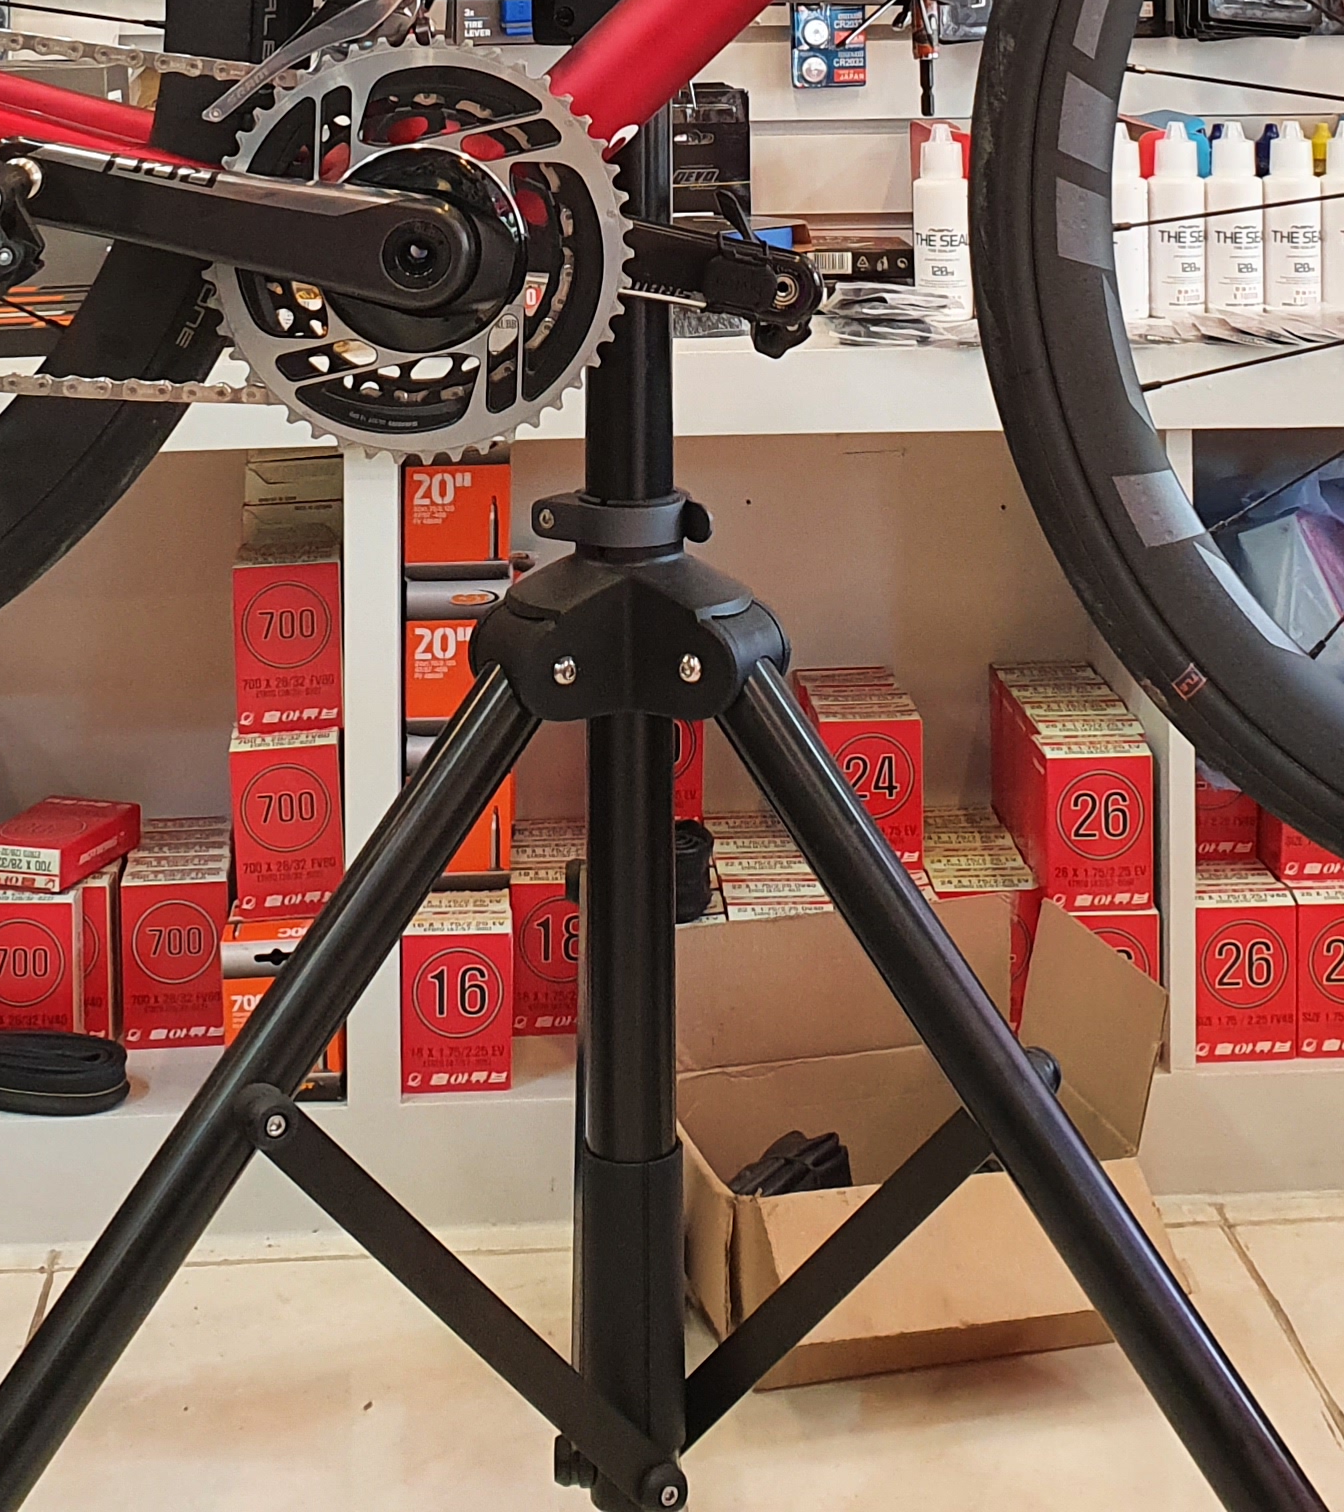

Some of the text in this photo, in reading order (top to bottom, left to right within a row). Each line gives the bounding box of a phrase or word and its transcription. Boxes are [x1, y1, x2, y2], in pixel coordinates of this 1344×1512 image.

[464, 21, 484, 29] TIRE
[464, 29, 492, 38] LEVER
[833, 56, 866, 68] CR2032
[915, 231, 938, 247] THE
[1158, 229, 1206, 244] THE SE
[1214, 230, 1264, 245] THE SE
[1271, 229, 1321, 244] THE SE
[257, 607, 317, 641] 700
[844, 754, 901, 800] 24
[256, 791, 316, 824] 700
[1070, 789, 1130, 840] 26
[145, 926, 204, 959] 700
[533, 916, 580, 963] 18
[1215, 940, 1273, 988] 26
[427, 965, 489, 1018] 16
